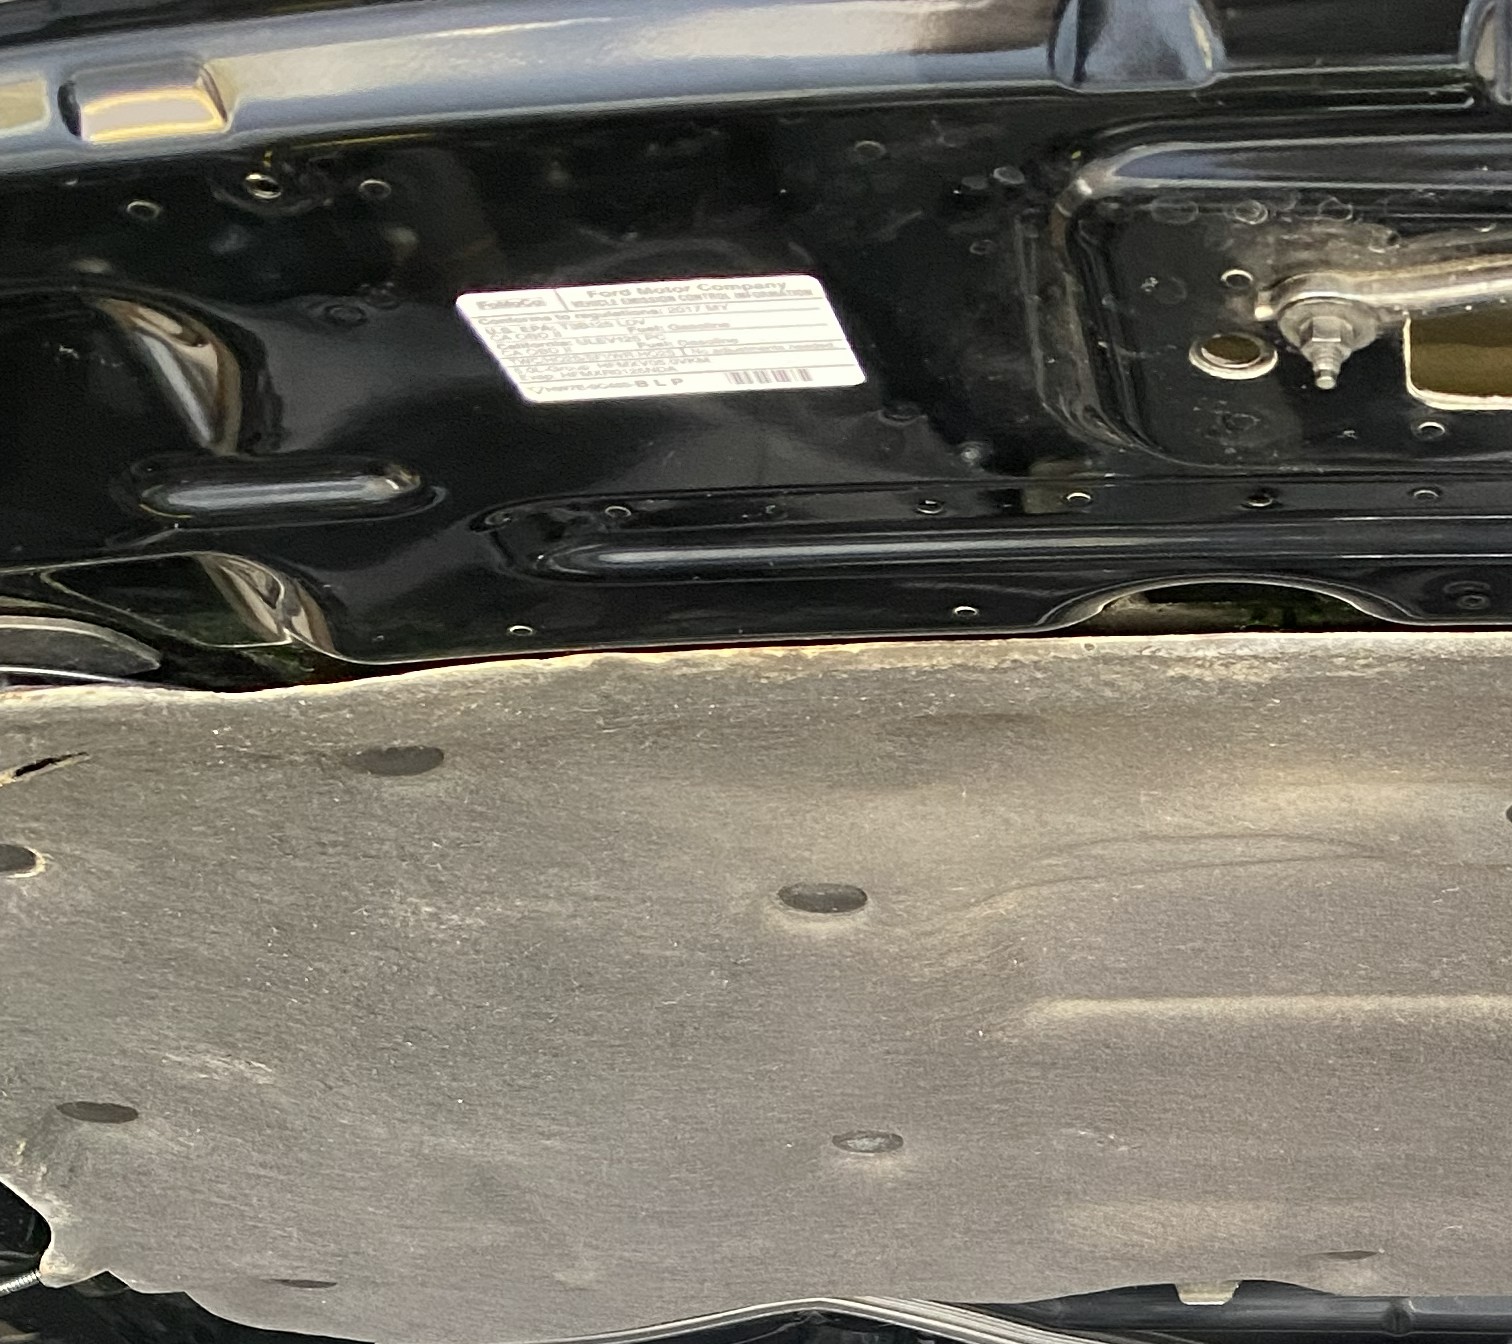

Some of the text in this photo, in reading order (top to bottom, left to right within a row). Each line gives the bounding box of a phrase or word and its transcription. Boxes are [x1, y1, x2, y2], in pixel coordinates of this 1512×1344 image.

[586, 279, 787, 297] Ford Motor Company
